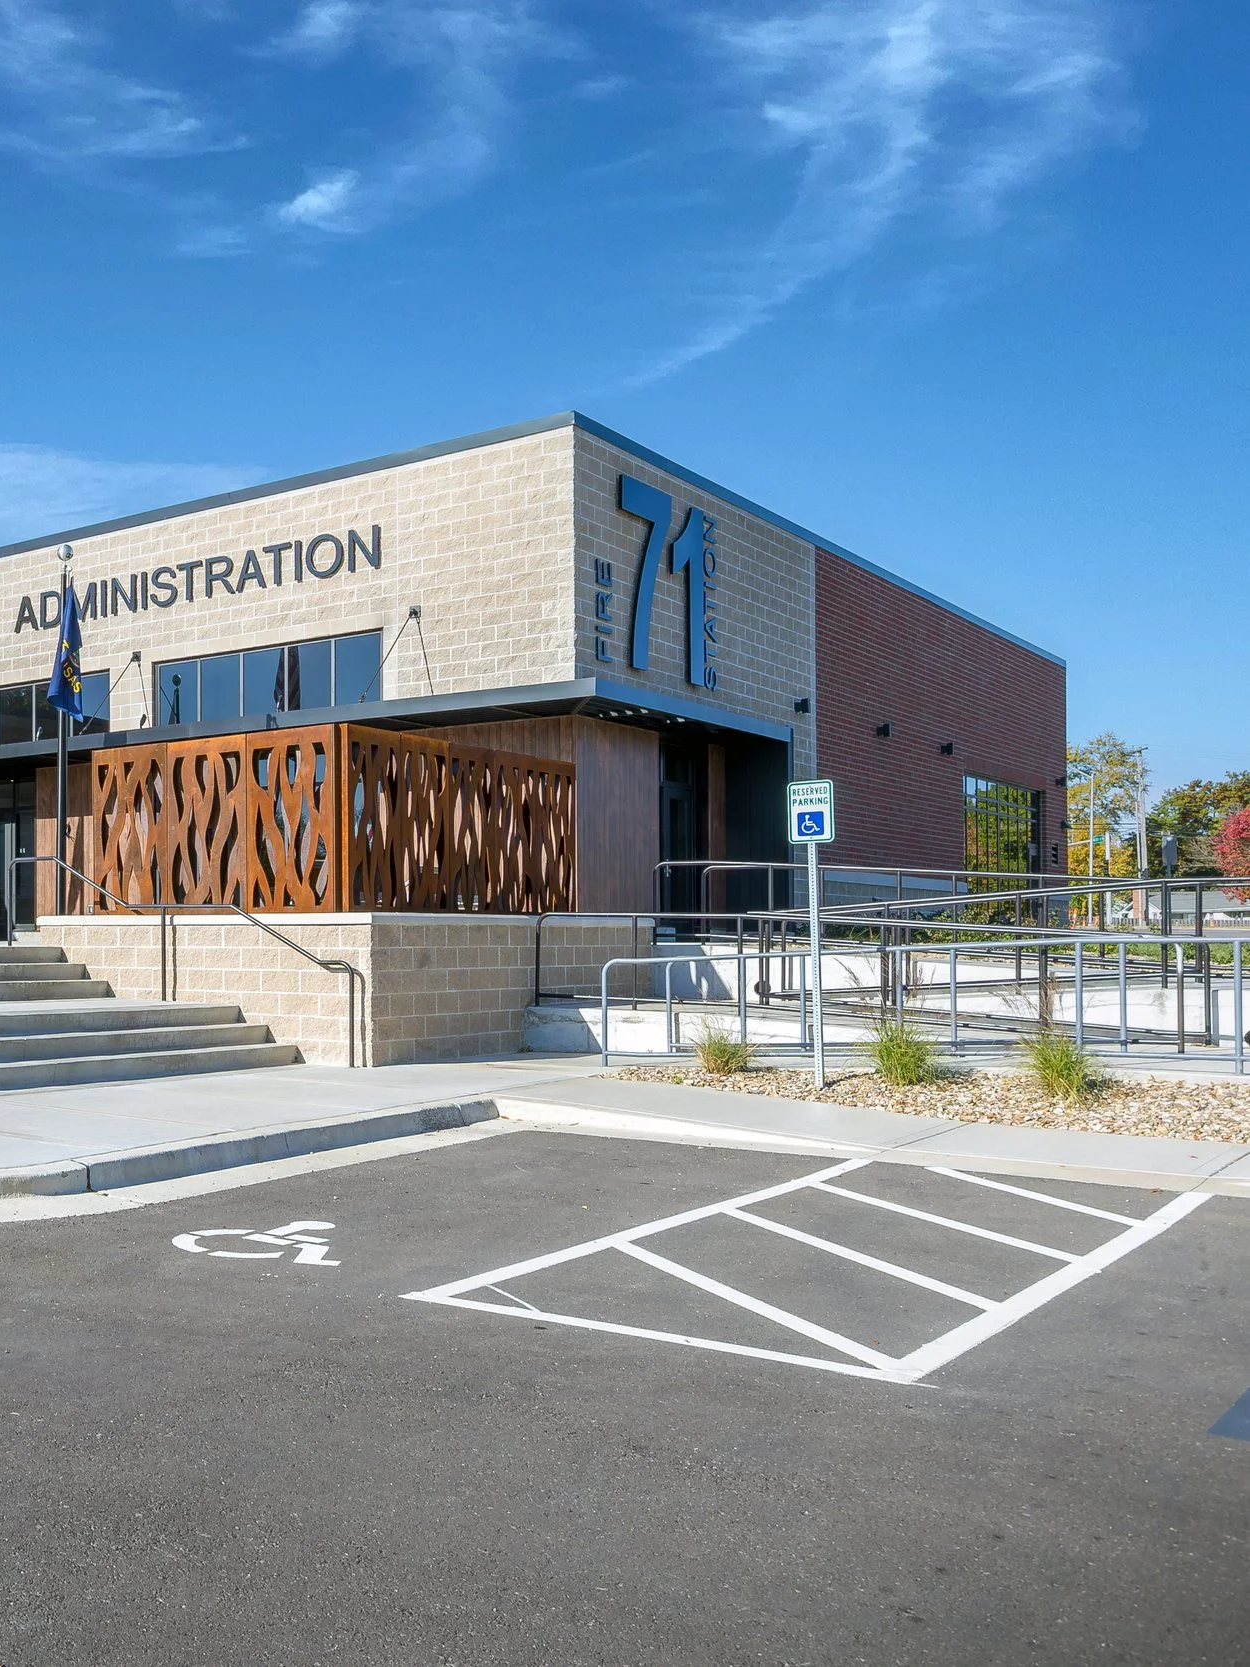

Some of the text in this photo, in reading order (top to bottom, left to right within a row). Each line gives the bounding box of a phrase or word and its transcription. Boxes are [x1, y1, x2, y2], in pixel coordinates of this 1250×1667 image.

[14, 525, 381, 634] ADMINISTRATION
[596, 558, 613, 663] FIRE
[619, 475, 705, 686] 71
[704, 515, 719, 691] STATION
[792, 786, 828, 797] RESERVED
[792, 797, 829, 807] PARKING
